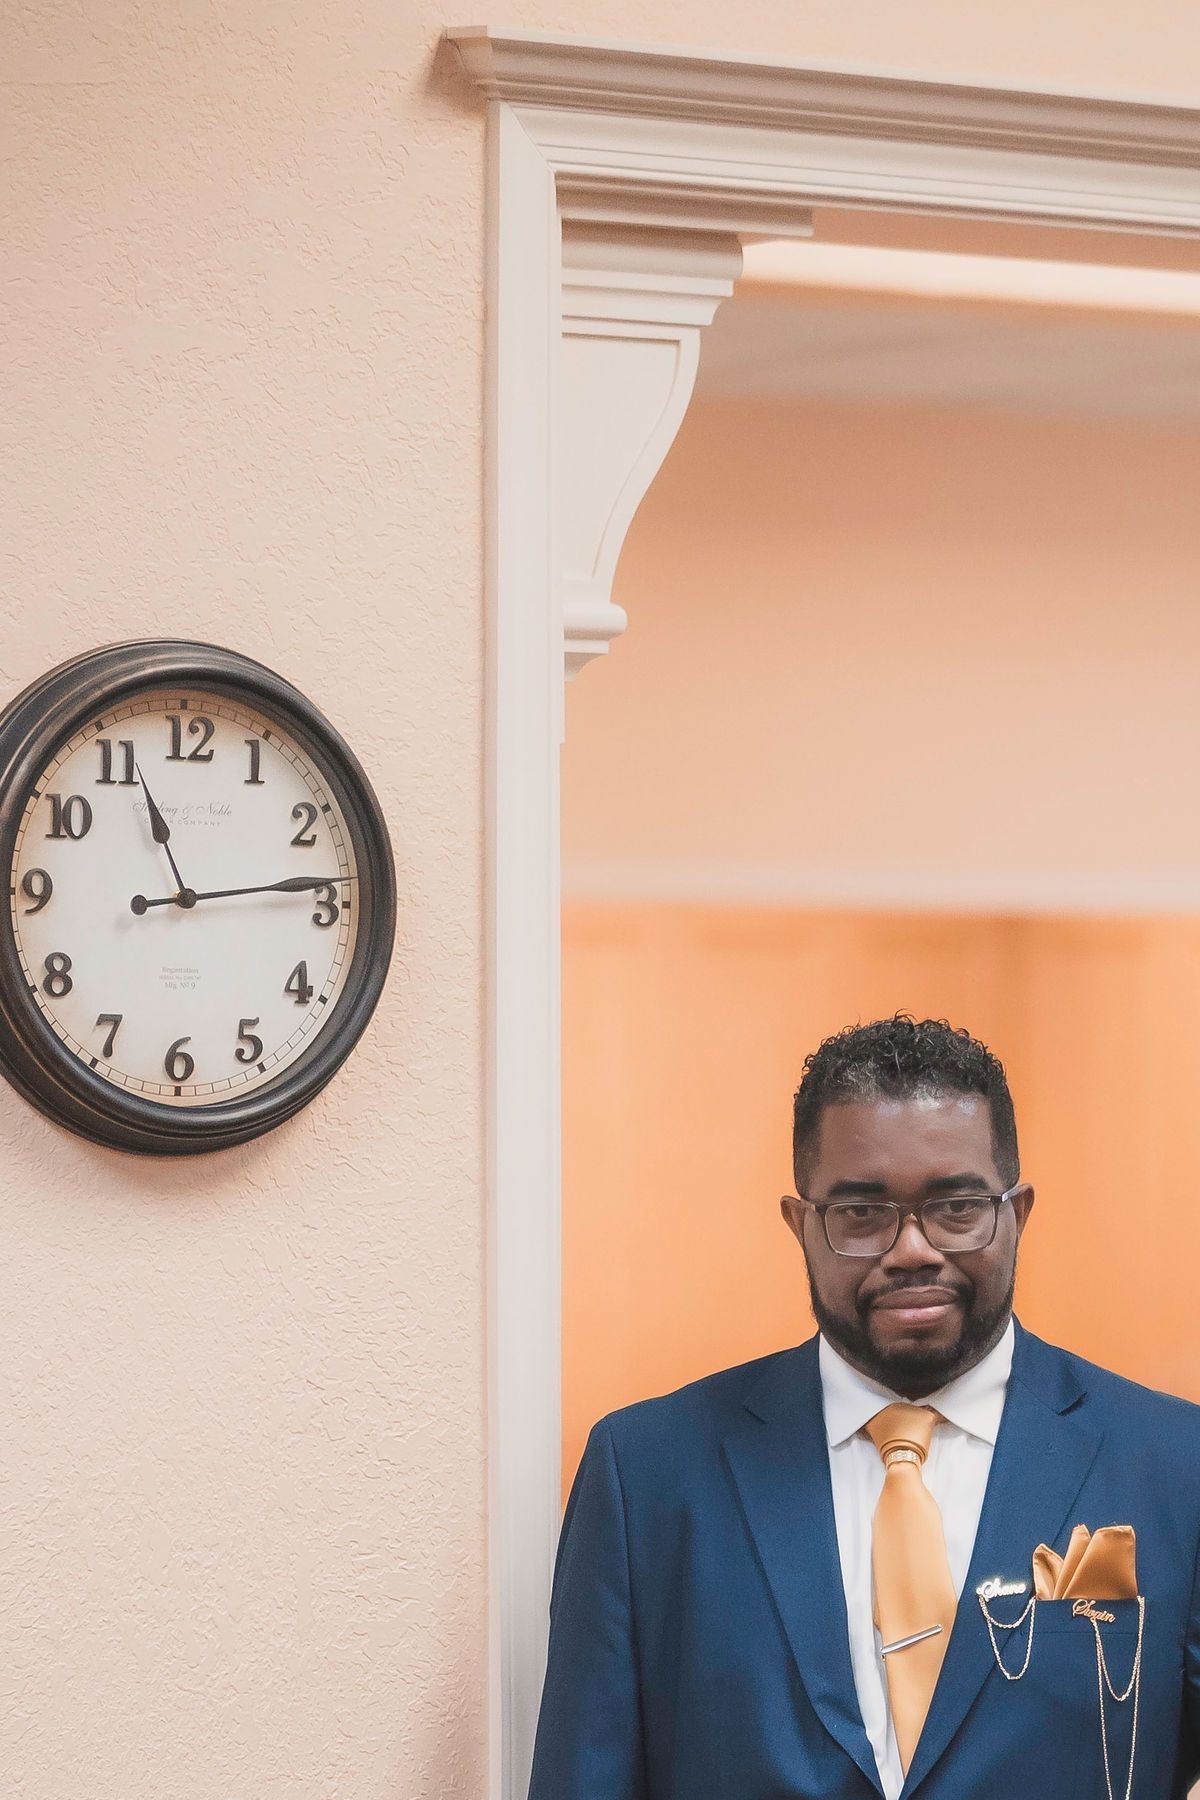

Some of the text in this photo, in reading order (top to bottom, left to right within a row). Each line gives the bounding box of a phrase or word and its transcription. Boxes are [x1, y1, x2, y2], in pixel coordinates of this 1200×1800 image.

[165, 714, 216, 762] 12
[244, 738, 266, 784] 1
[95, 738, 139, 785] 11
[45, 793, 92, 840] 10
[132, 800, 179, 816] Stling
[196, 803, 232, 817] Noble
[290, 801, 319, 847] 2
[22, 868, 52, 914] 9
[311, 884, 340, 927] 3
[42, 952, 73, 998] 8
[284, 960, 314, 1005] 4
[95, 1014, 123, 1059] 7
[164, 1036, 195, 1082] 6
[235, 1017, 263, 1064] 5
